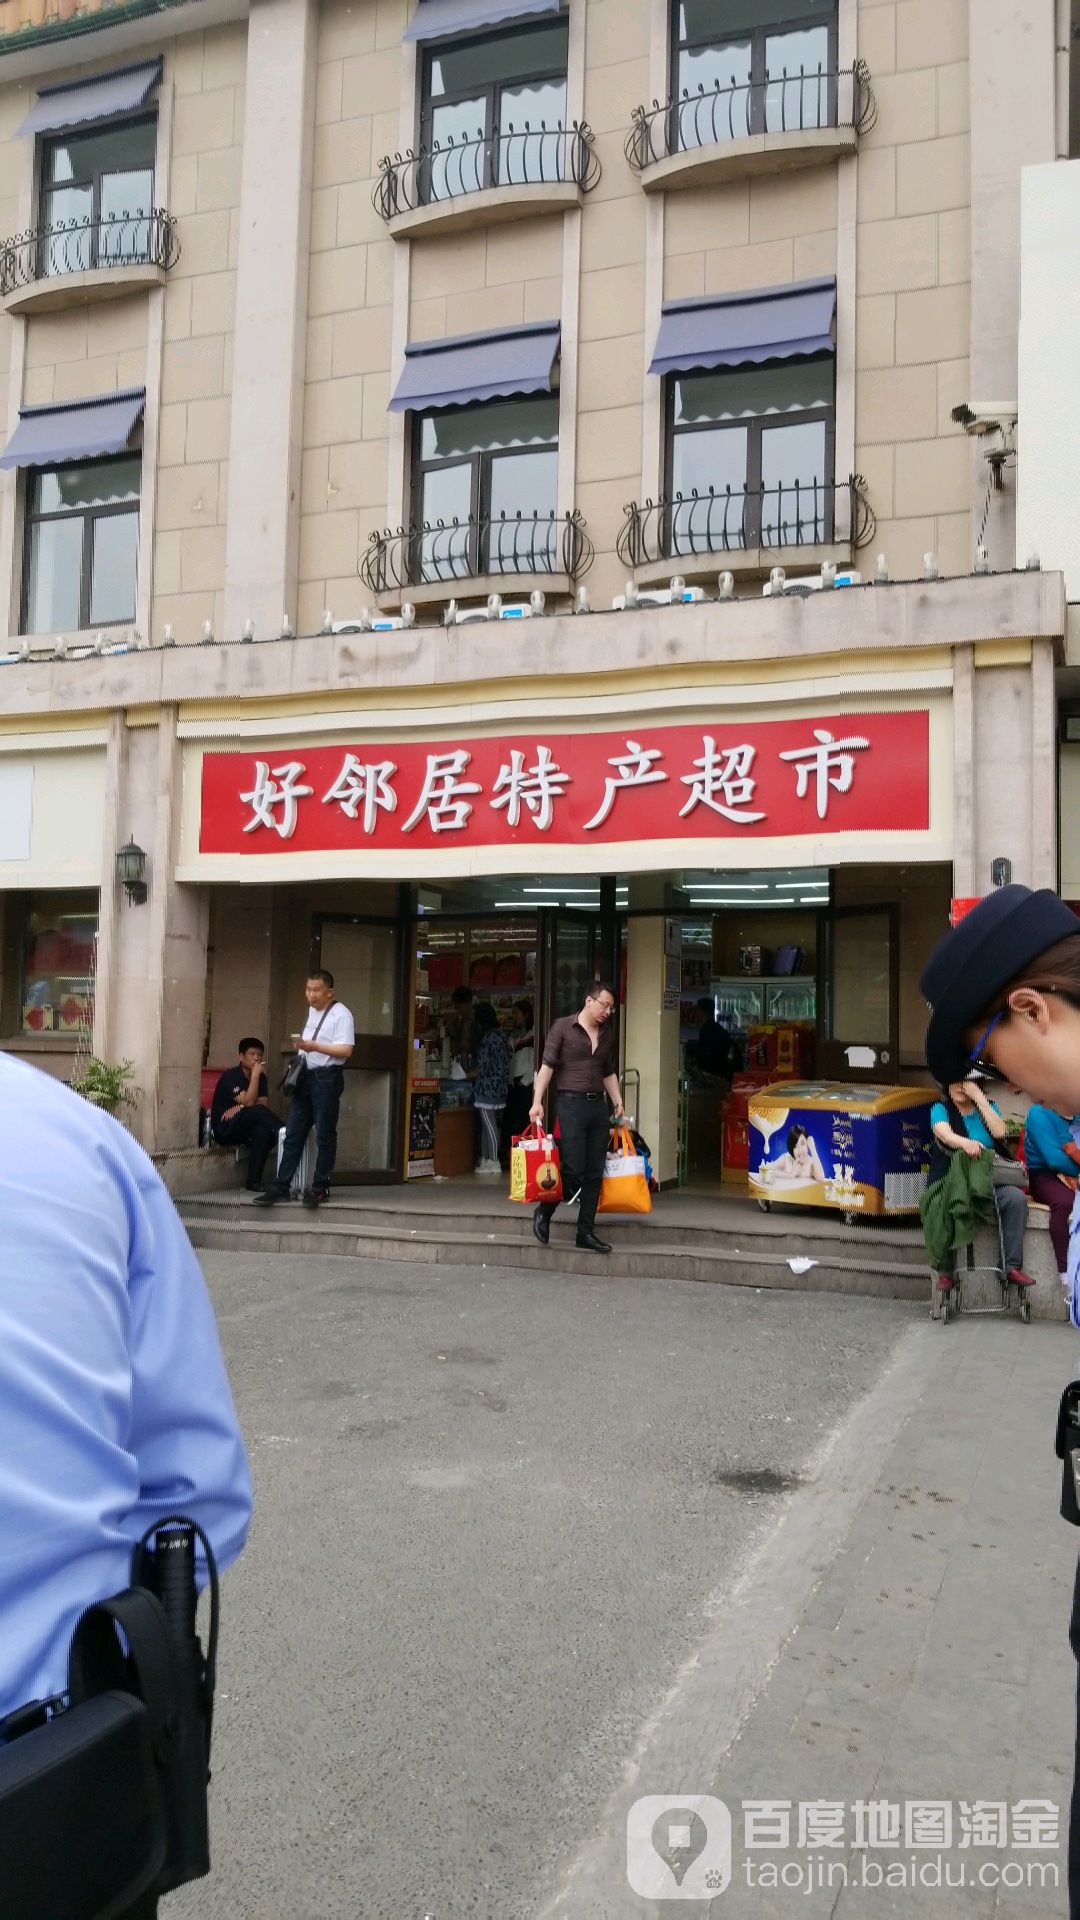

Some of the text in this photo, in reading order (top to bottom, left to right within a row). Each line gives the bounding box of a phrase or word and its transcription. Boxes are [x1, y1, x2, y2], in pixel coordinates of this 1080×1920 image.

[239, 729, 870, 839] 好邻居特产超市
